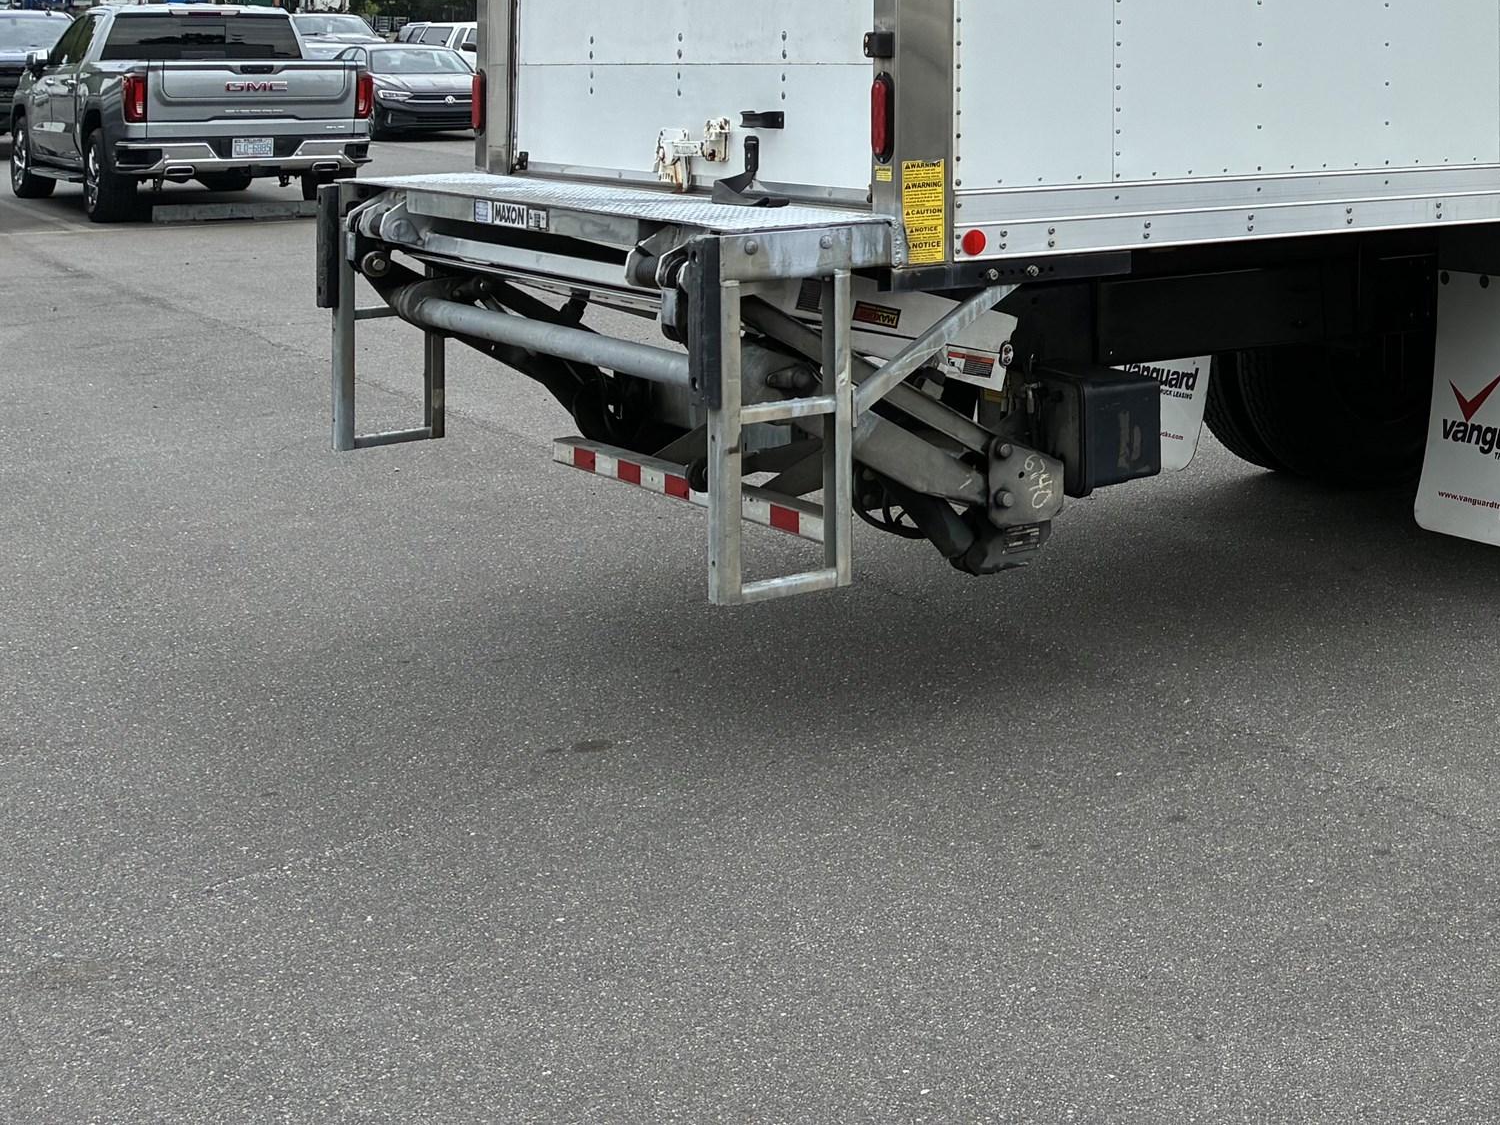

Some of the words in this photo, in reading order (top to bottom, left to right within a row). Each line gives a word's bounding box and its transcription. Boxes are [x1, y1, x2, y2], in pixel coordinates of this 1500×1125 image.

[225, 81, 288, 92] GMC
[910, 161, 941, 169] WARNING
[911, 181, 942, 189] WARNING
[494, 203, 525, 225] MAXON
[911, 208, 942, 216] CAUTION
[912, 241, 942, 249] NOTICE
